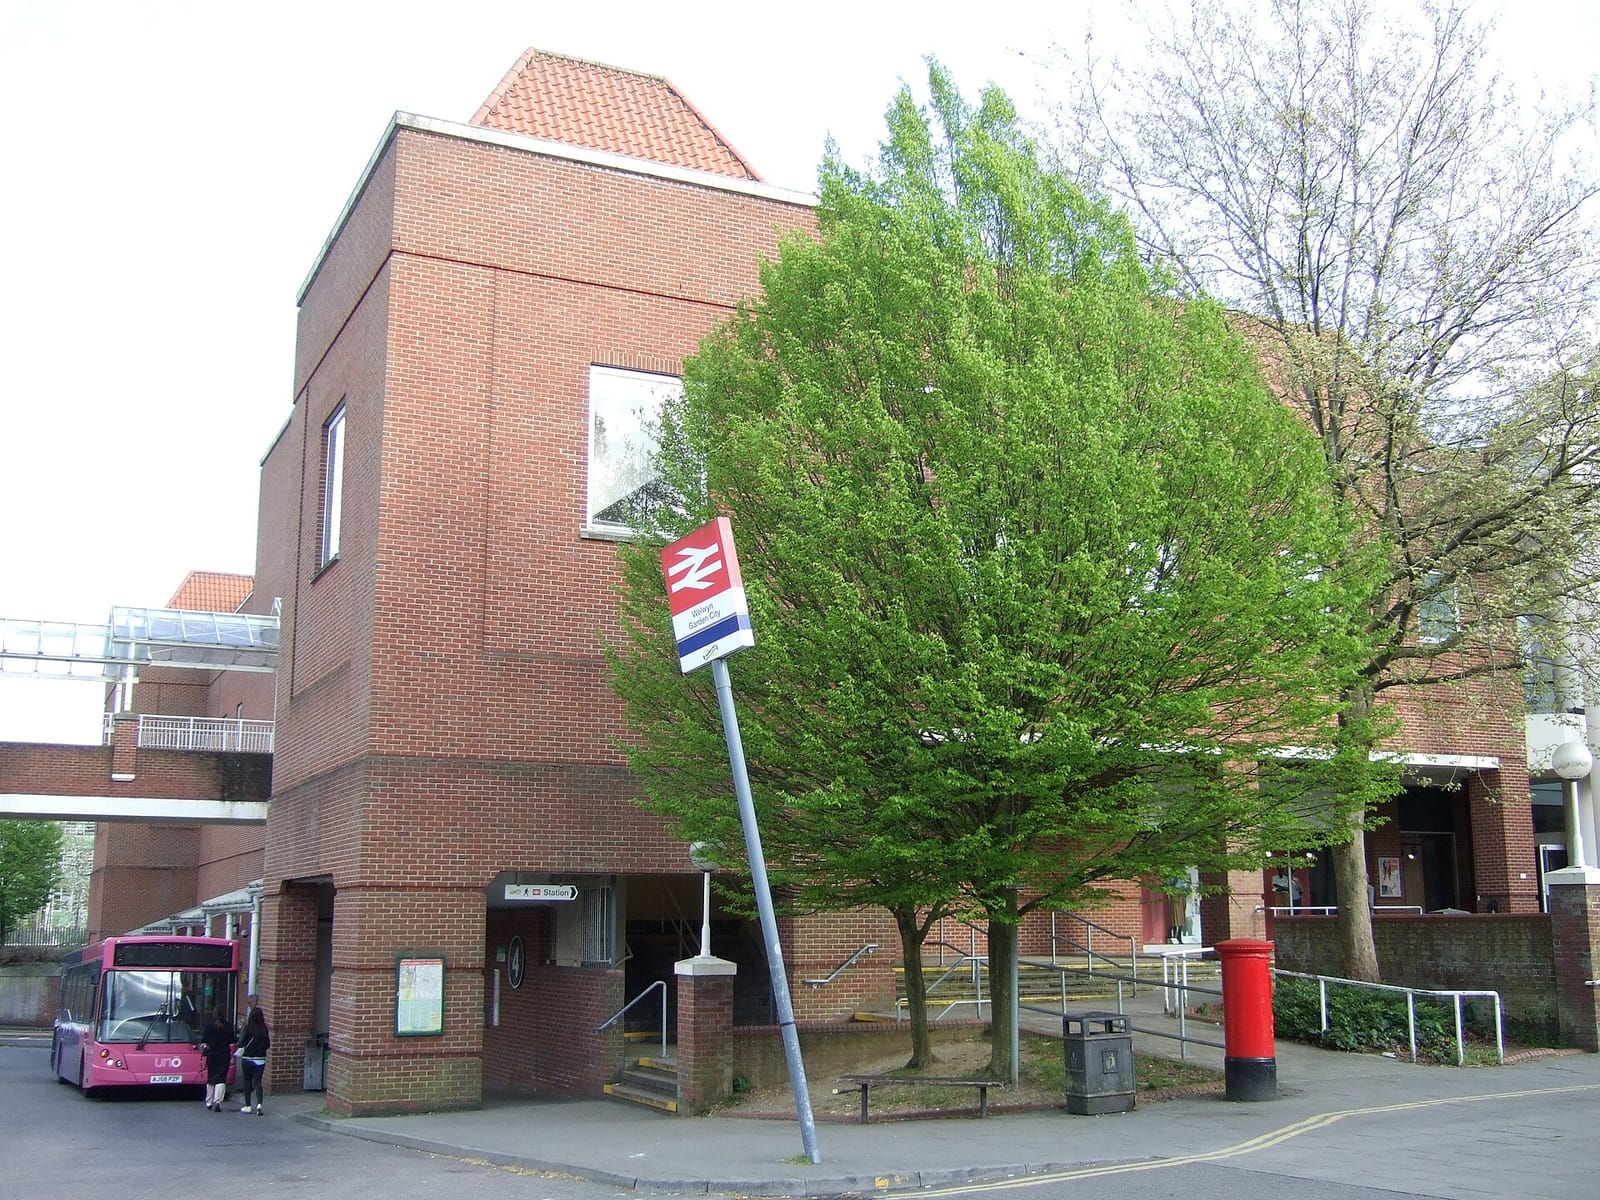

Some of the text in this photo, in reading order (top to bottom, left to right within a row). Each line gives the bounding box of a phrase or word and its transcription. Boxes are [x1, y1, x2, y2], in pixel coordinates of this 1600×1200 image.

[691, 603, 714, 618] Welwyn
[688, 610, 720, 630] Garden City
[544, 888, 569, 896] Station
[512, 947, 519, 978] 4
